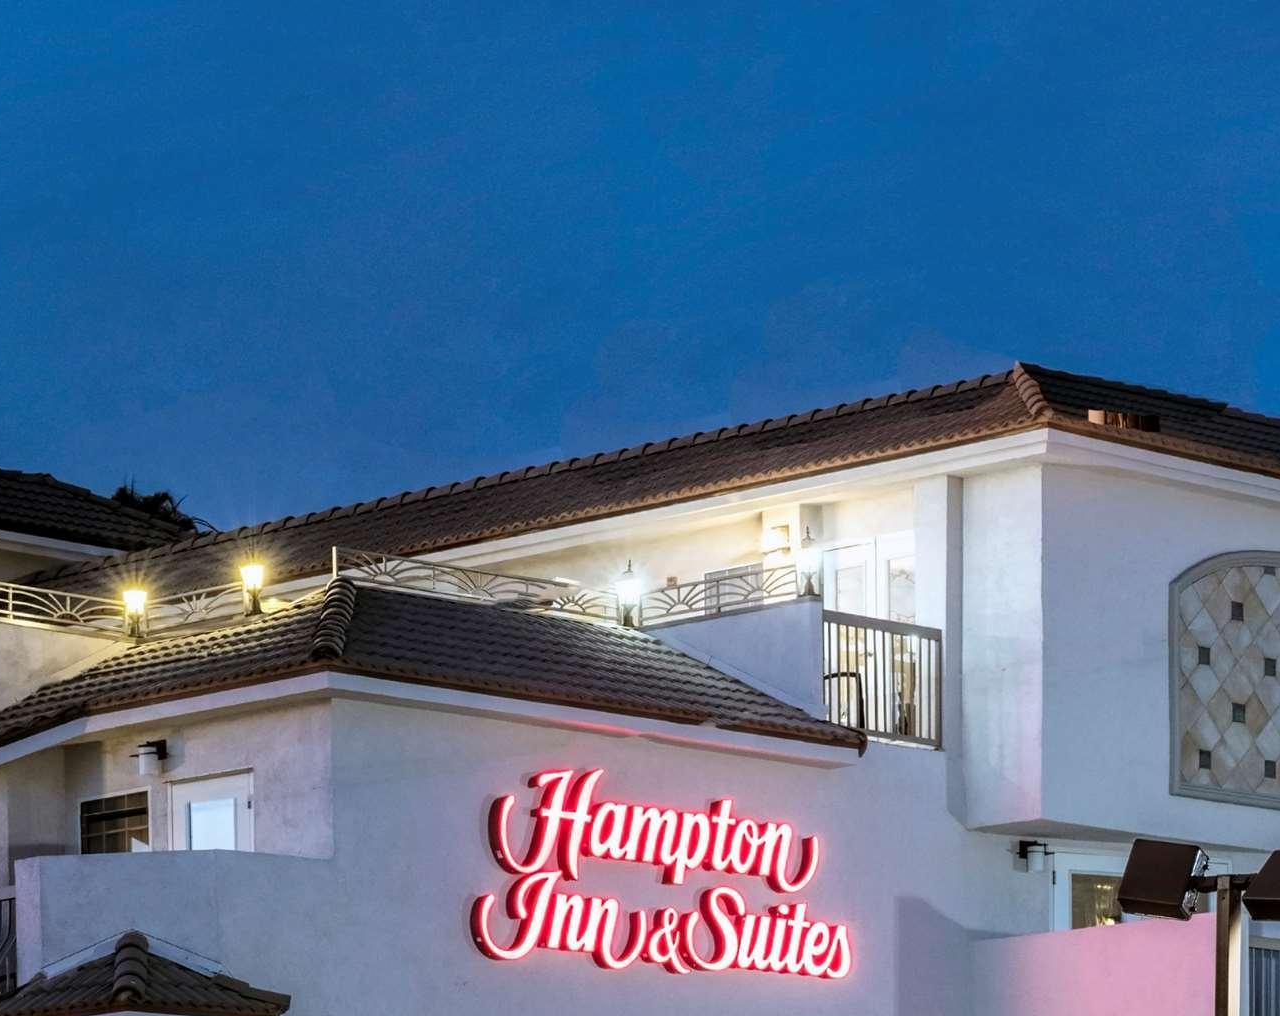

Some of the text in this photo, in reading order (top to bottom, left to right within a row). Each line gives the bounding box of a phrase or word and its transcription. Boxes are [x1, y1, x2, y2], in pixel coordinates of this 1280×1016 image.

[489, 768, 820, 893] Hampton
[471, 871, 853, 979] Inn & Suites
